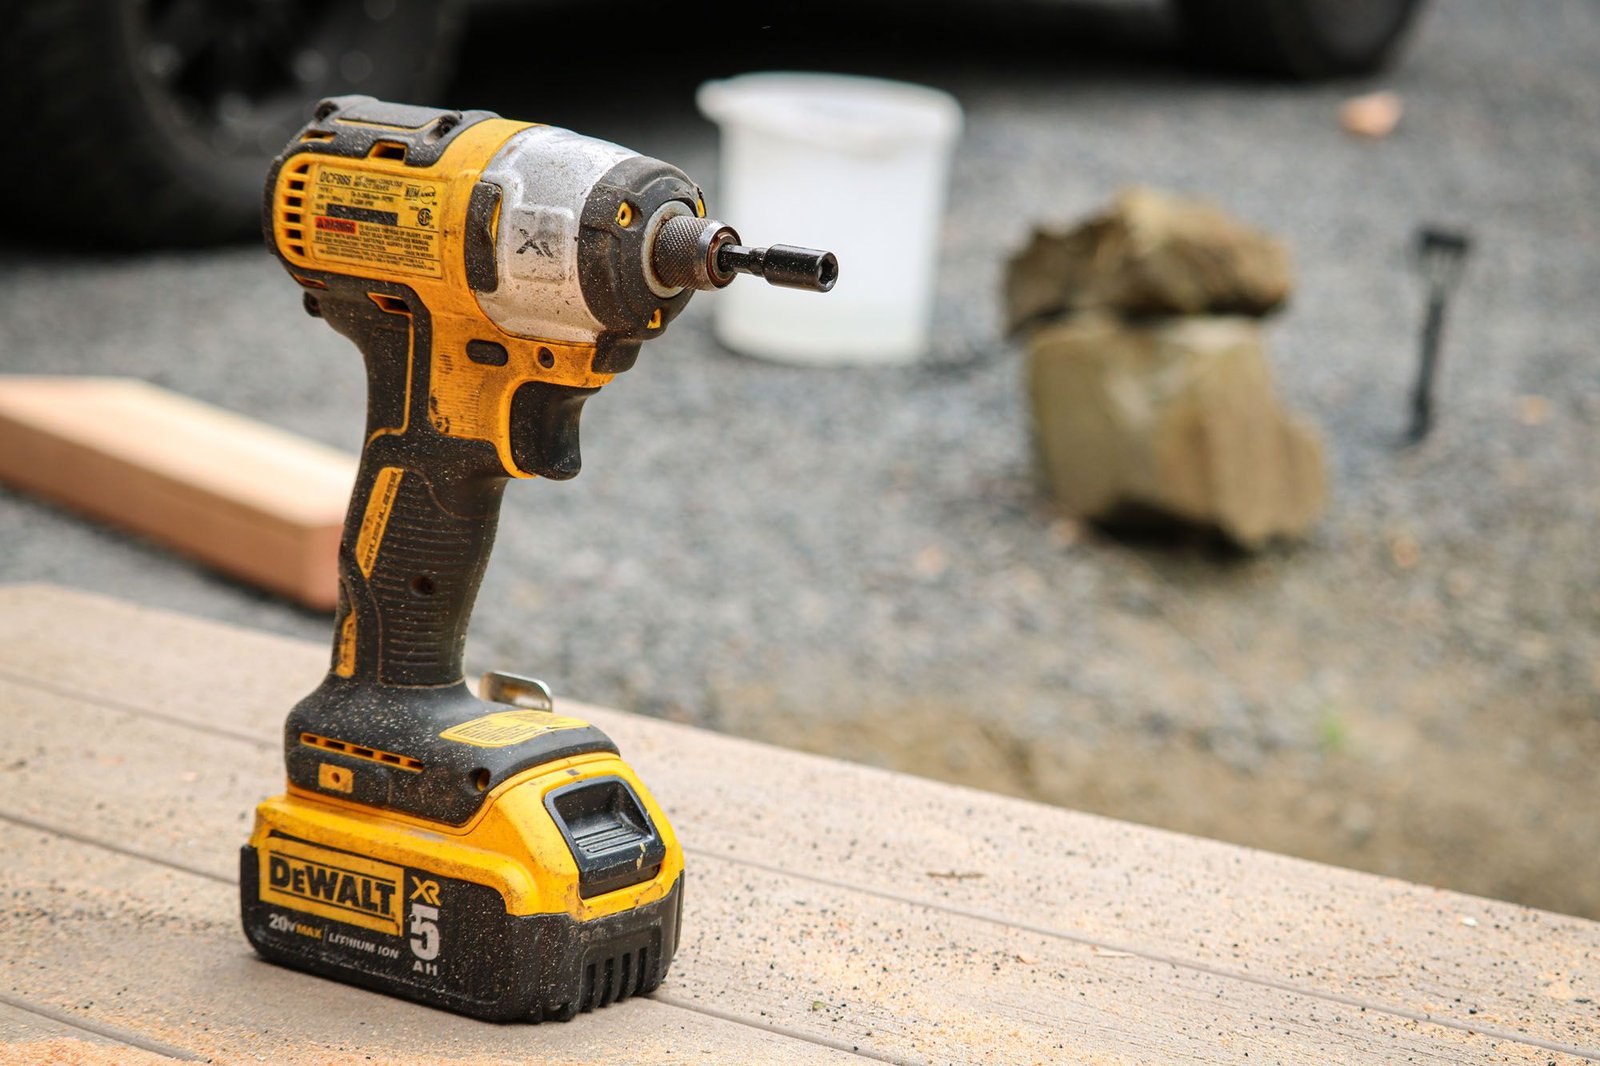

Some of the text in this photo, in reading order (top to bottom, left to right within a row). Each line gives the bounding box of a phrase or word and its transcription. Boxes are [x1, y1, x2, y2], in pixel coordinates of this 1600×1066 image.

[409, 875, 441, 907] XR
[296, 923, 322, 940] MAX
[328, 932, 399, 959] LITHIUM ION
[409, 903, 440, 961] 5
